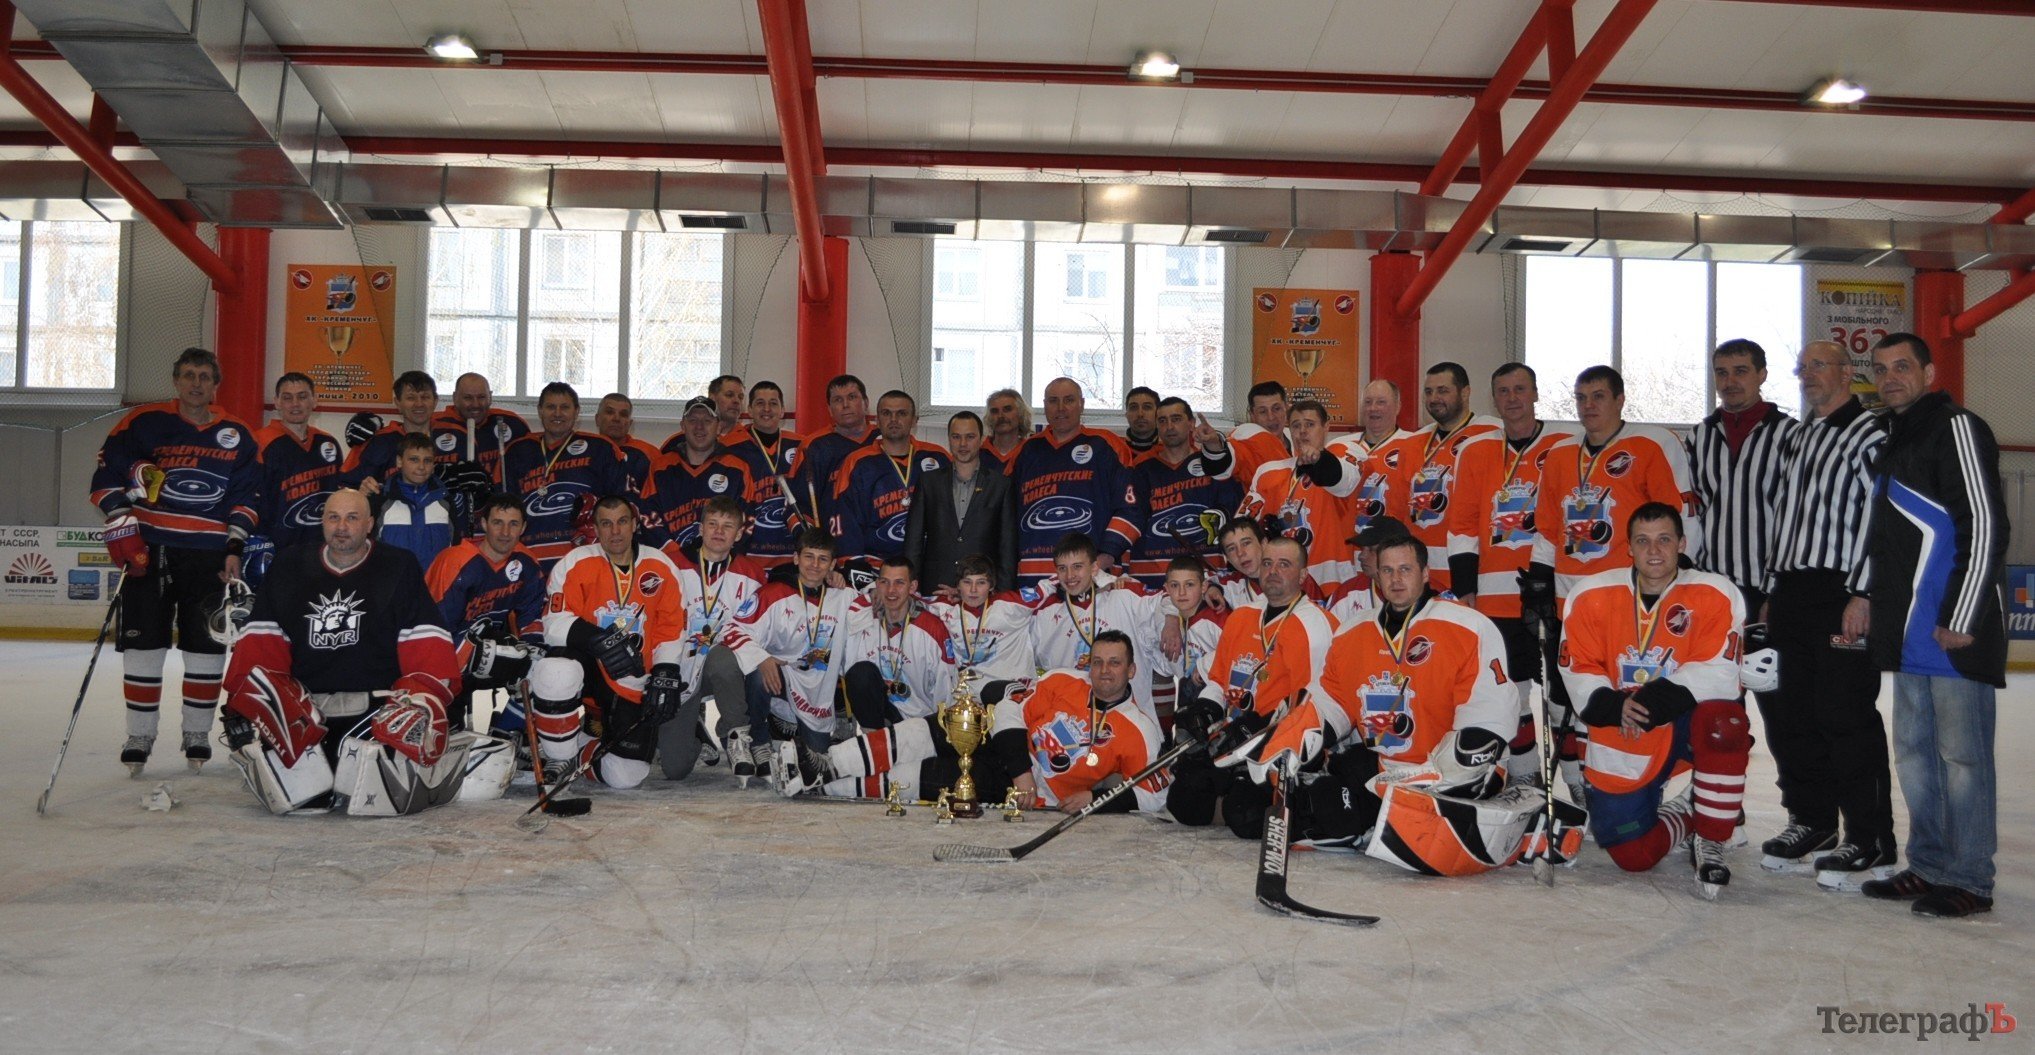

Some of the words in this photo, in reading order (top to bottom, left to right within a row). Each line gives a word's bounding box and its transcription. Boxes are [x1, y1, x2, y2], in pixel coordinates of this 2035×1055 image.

[1834, 317, 1889, 325] МОБІЛЬНОГО
[313, 631, 356, 646] NYR
[1489, 658, 1507, 685] 1
[1081, 776, 1134, 816] BAUER
